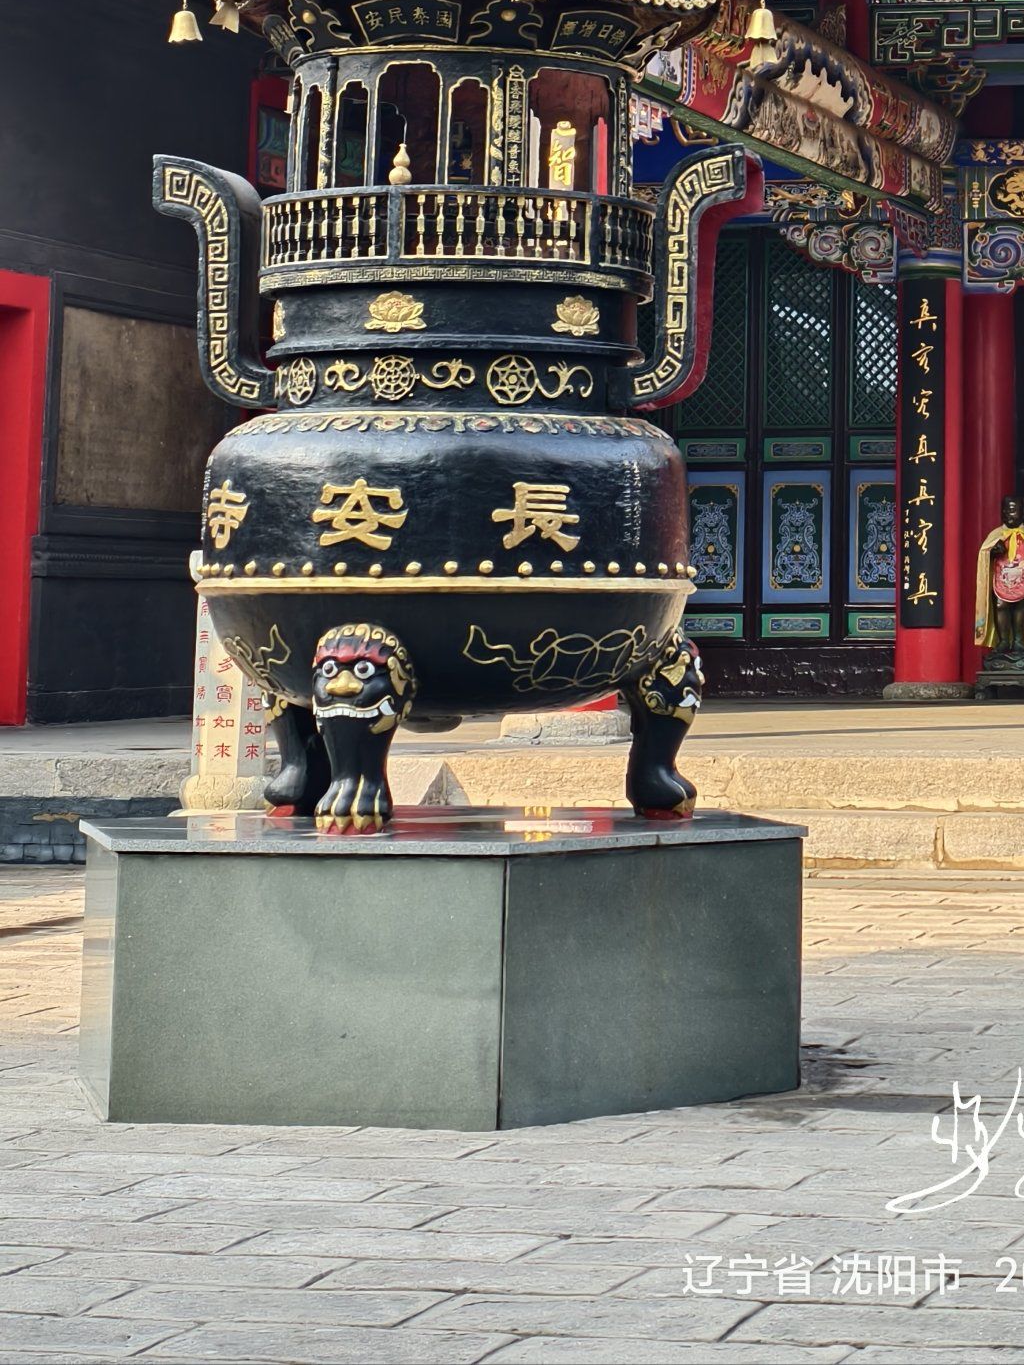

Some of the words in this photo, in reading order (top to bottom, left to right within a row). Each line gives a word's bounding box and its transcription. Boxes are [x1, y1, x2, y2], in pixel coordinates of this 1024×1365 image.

[364, 6, 454, 32] 國泰民安
[548, 139, 576, 187] 智
[207, 477, 581, 553] 長安寺
